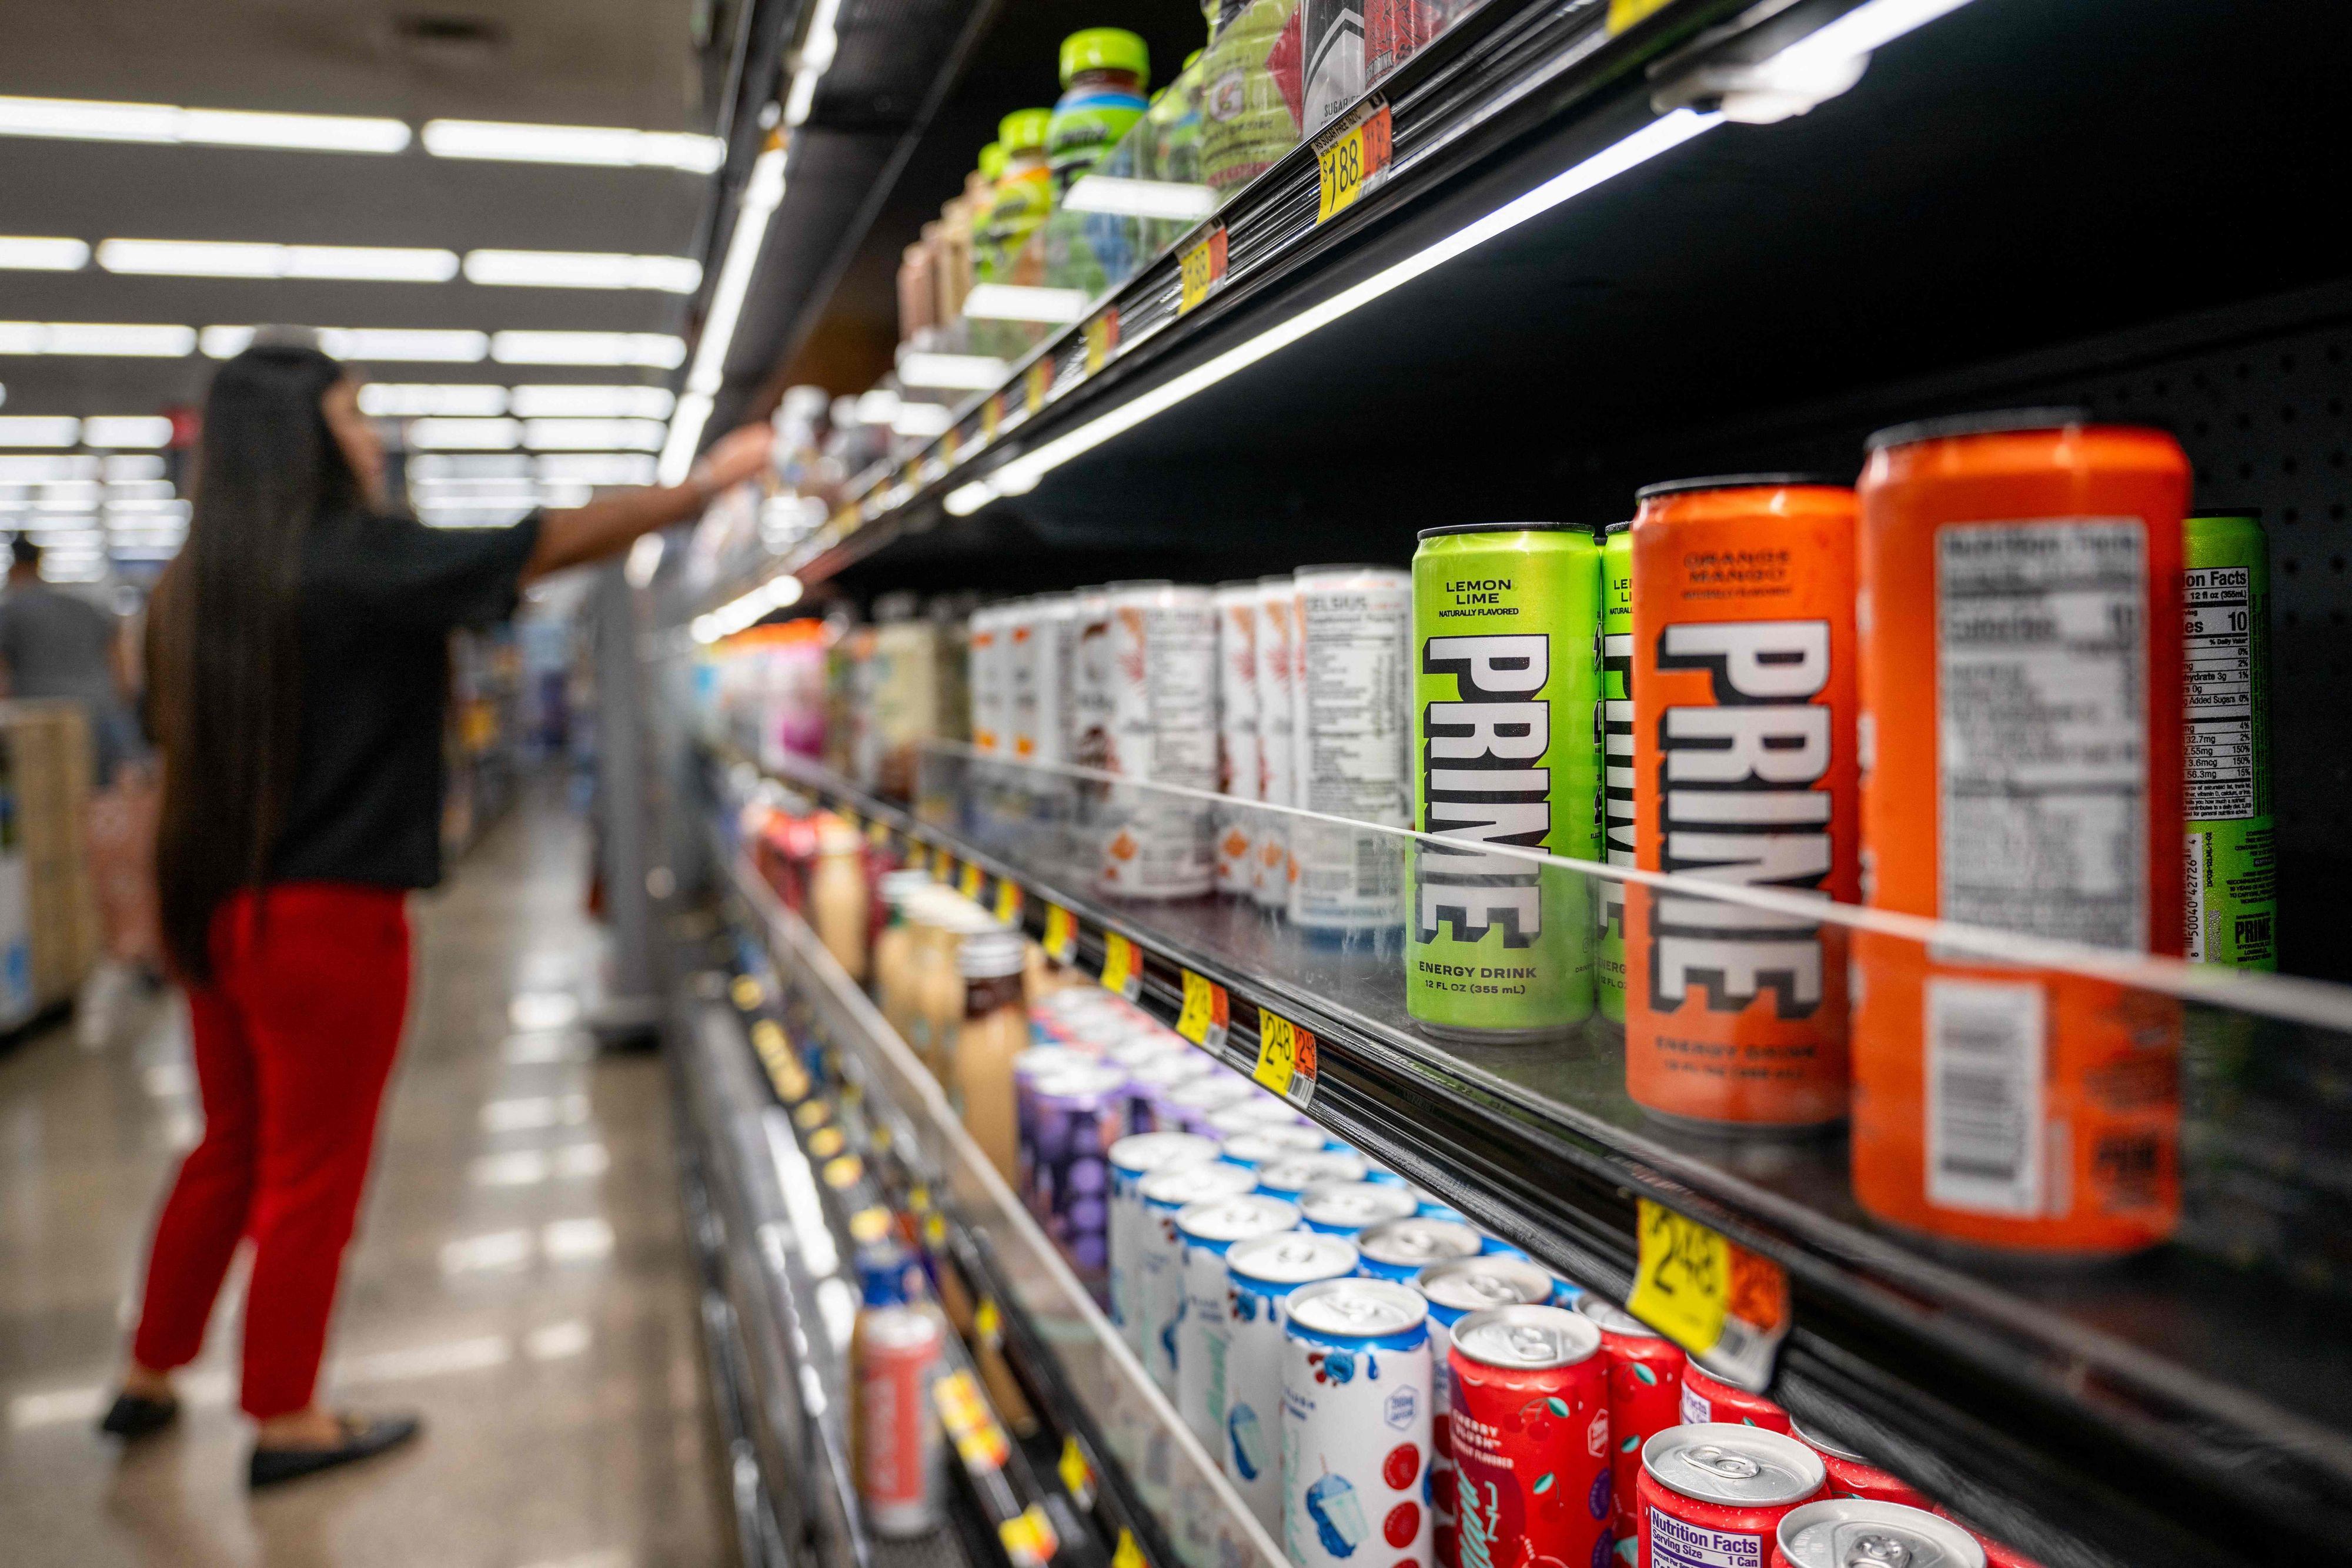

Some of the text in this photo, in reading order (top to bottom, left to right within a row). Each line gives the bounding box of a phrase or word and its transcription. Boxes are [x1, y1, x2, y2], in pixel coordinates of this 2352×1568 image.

[1324, 98, 1348, 117] SUGAR
[1319, 129, 1338, 146] SUGAR
[1335, 120, 1349, 135] FREE
[2210, 570, 2247, 586] Facts
[1446, 579, 1511, 593] LEMON
[1456, 593, 1499, 605] LIME
[2202, 591, 2208, 599] fl
[1439, 608, 1519, 618] NATURALLY FLAVORED
[2228, 611, 2247, 631] 10
[2238, 647, 2248, 656] 0%
[2217, 672, 2227, 681] 3g
[2239, 671, 2249, 679] 1%
[2192, 685, 2202, 694] 0g
[2189, 696, 2211, 704] Added
[2213, 695, 2236, 705] Sugars
[2239, 694, 2249, 703] 0%
[2240, 721, 2250, 730] 4%
[2240, 733, 2250, 741] 2%
[2233, 745, 2250, 754] 150%
[2233, 756, 2250, 765] 150%
[2187, 768, 2251, 780] 56.3mg 15%
[1414, 633, 1551, 949] PRIME
[1649, 619, 1832, 1019] PRIME
[2187, 860, 2198, 895] 42726
[2187, 901, 2199, 937] 50040
[1419, 960, 1538, 979] ENERGY DRINK
[1425, 979, 1526, 995] 12 FL OZ (355 mL)
[1608, 978, 1616, 988] FL
[1652, 1510, 1758, 1554] Nutrition Facts
[1652, 1529, 1702, 1559] Serving Size
[1653, 1548, 1669, 1563] Amount
[1670, 1558, 1678, 1567] Per
[1728, 1556, 1758, 1567] 1 Can
